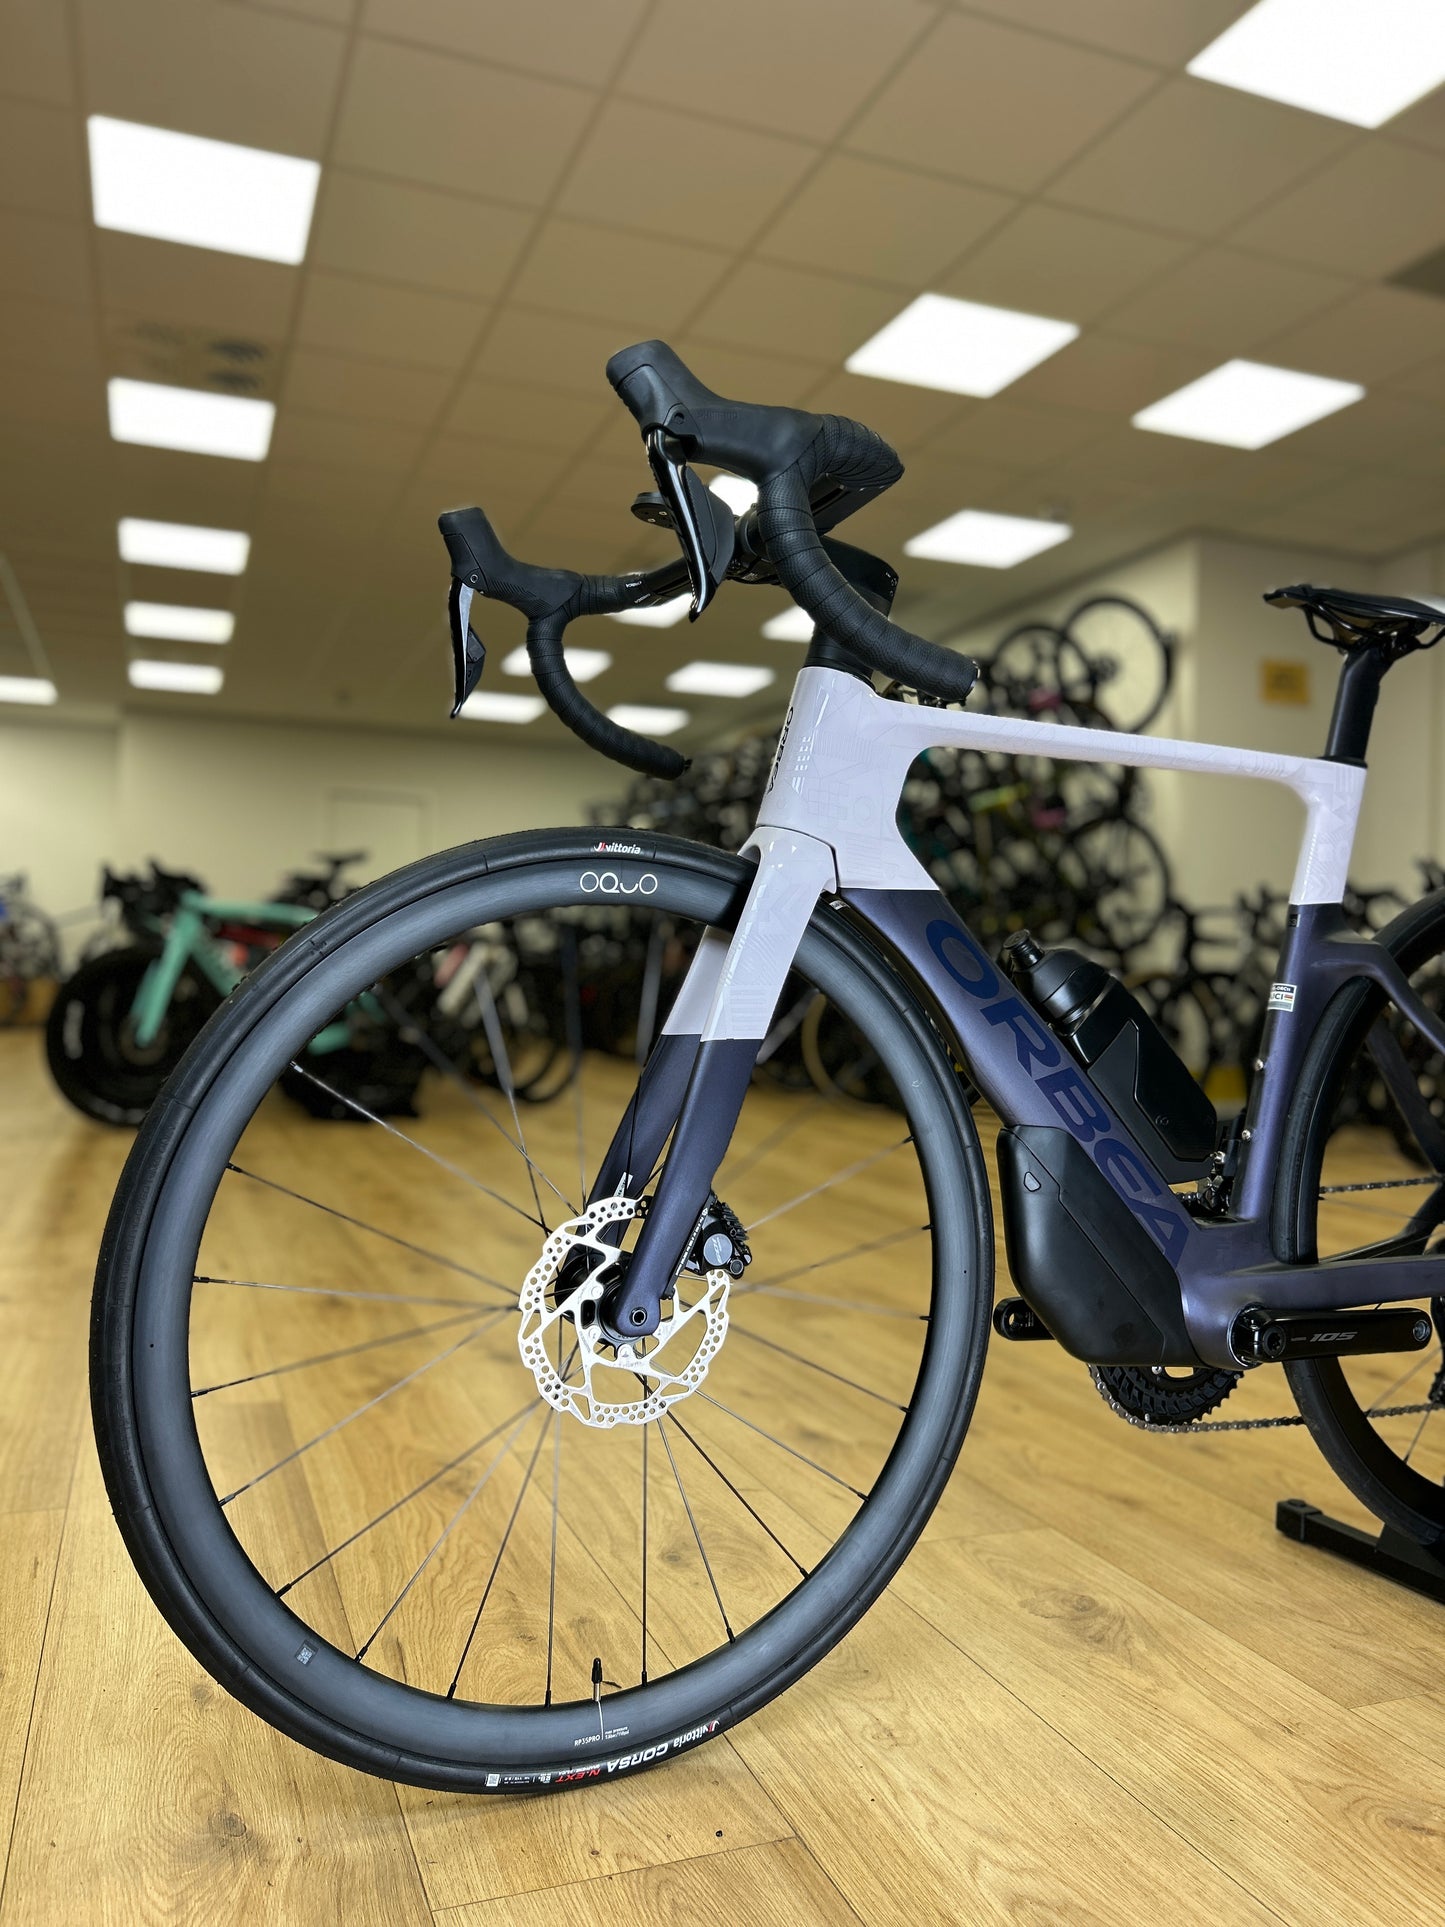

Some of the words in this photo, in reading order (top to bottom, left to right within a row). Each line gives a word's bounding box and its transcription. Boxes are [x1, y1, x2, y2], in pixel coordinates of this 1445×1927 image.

[605, 842, 642, 855] vittoria
[580, 871, 658, 895] OQUO
[925, 919, 1189, 1271] ORBEA
[1310, 1331, 1358, 1342] 105
[673, 1724, 710, 1749] vittoria
[606, 1742, 669, 1773] CORSA
[554, 1767, 601, 1783] N.EXT
